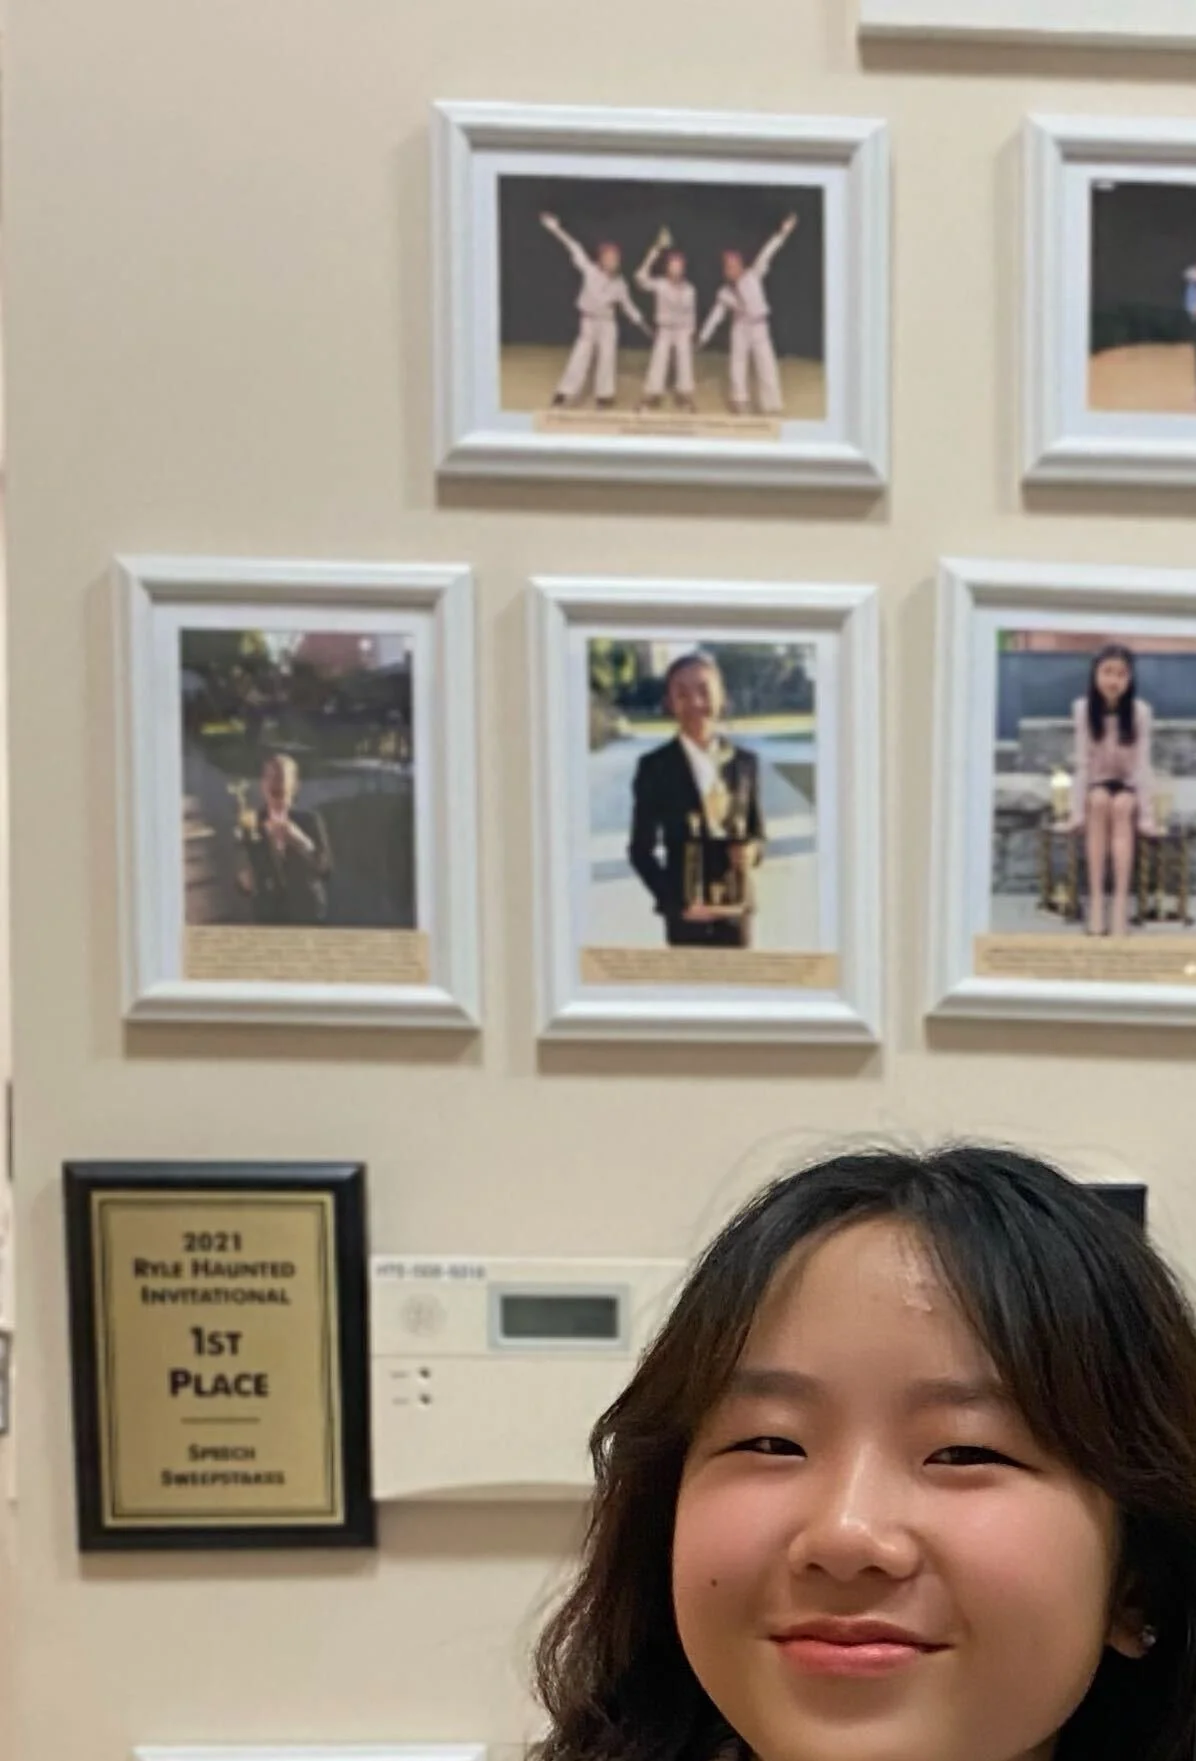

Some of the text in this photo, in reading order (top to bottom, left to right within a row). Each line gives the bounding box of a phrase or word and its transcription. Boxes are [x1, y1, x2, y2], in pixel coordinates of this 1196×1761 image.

[182, 1232, 242, 1252] 2021
[191, 1258, 296, 1278] HAUNTED
[141, 1285, 291, 1305] INVITATIONAL
[190, 1325, 243, 1356] 1ST
[169, 1368, 269, 1398] PLACE
